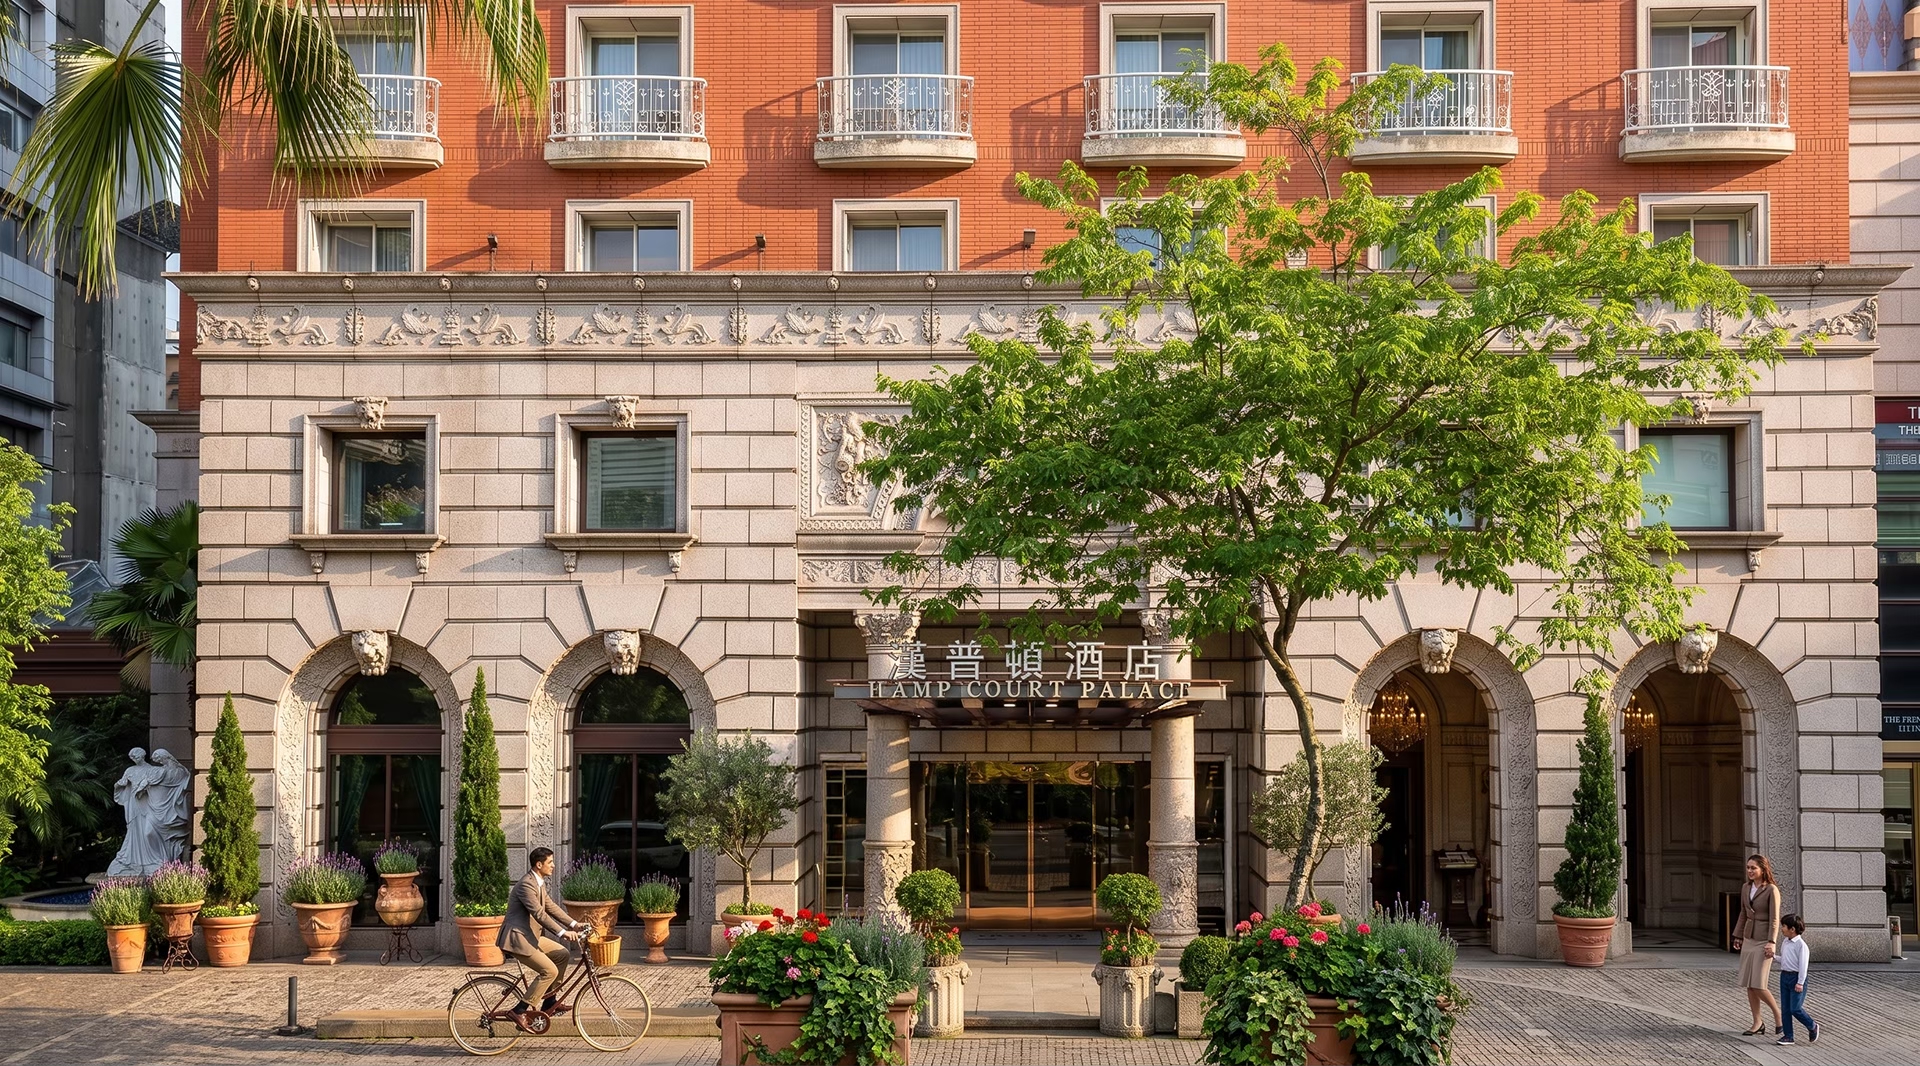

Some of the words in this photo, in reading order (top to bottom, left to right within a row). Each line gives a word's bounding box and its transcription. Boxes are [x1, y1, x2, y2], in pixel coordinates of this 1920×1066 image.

[888, 640, 1163, 680] 漢普頓酒店
[868, 681, 951, 698] HAMP
[967, 680, 1065, 698] COURT
